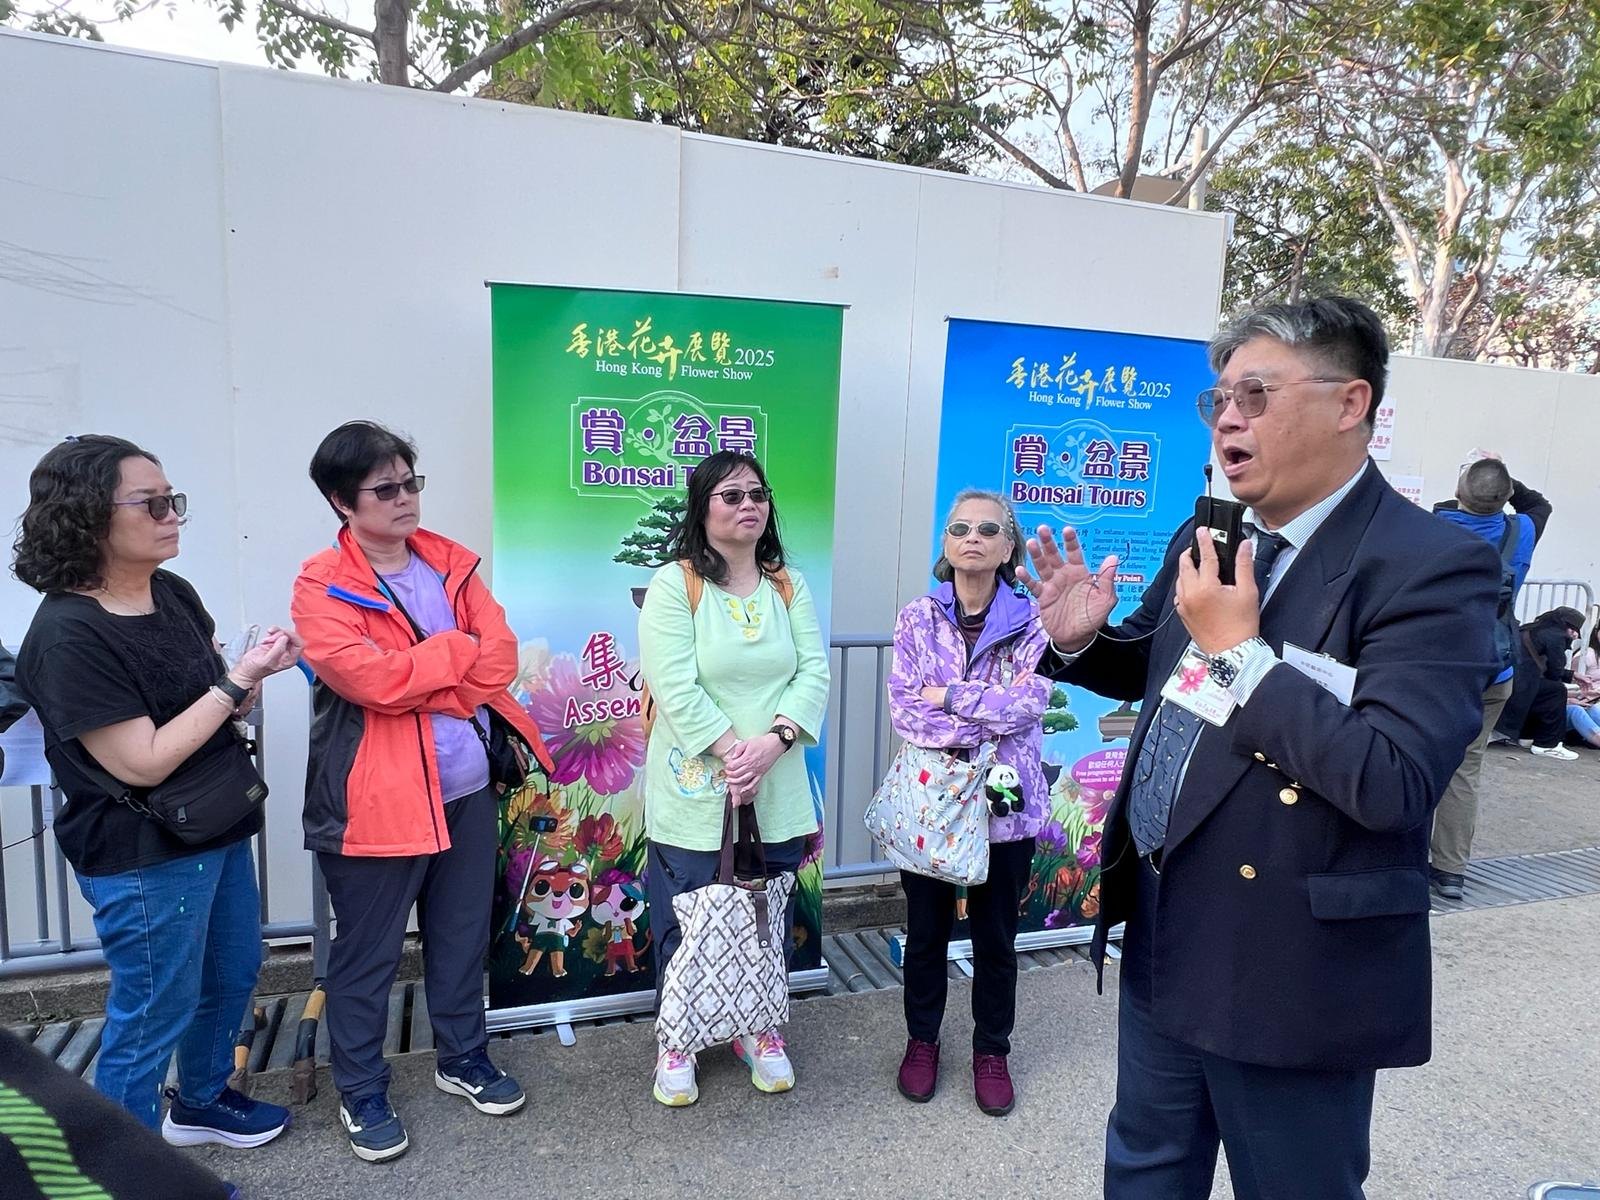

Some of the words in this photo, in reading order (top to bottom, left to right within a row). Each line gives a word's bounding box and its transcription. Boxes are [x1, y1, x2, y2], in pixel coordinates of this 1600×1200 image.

[565, 316, 732, 381] 香港花卉展覽
[735, 348, 775, 367] 2025
[595, 360, 628, 377] Hong
[632, 362, 662, 378] Kong
[681, 364, 719, 379] Flower
[723, 367, 753, 380] Show
[1006, 352, 1138, 410] 香港花卉展覽
[1138, 381, 1171, 398] 2025
[1029, 391, 1053, 405] Hong
[1057, 393, 1081, 407] Kong
[1095, 396, 1125, 409] Flower
[1128, 398, 1152, 410] Show
[583, 461, 675, 488] Bonsai
[1012, 481, 1082, 505] Bonsai
[1088, 485, 1145, 508] Tours
[580, 632, 628, 690] 集
